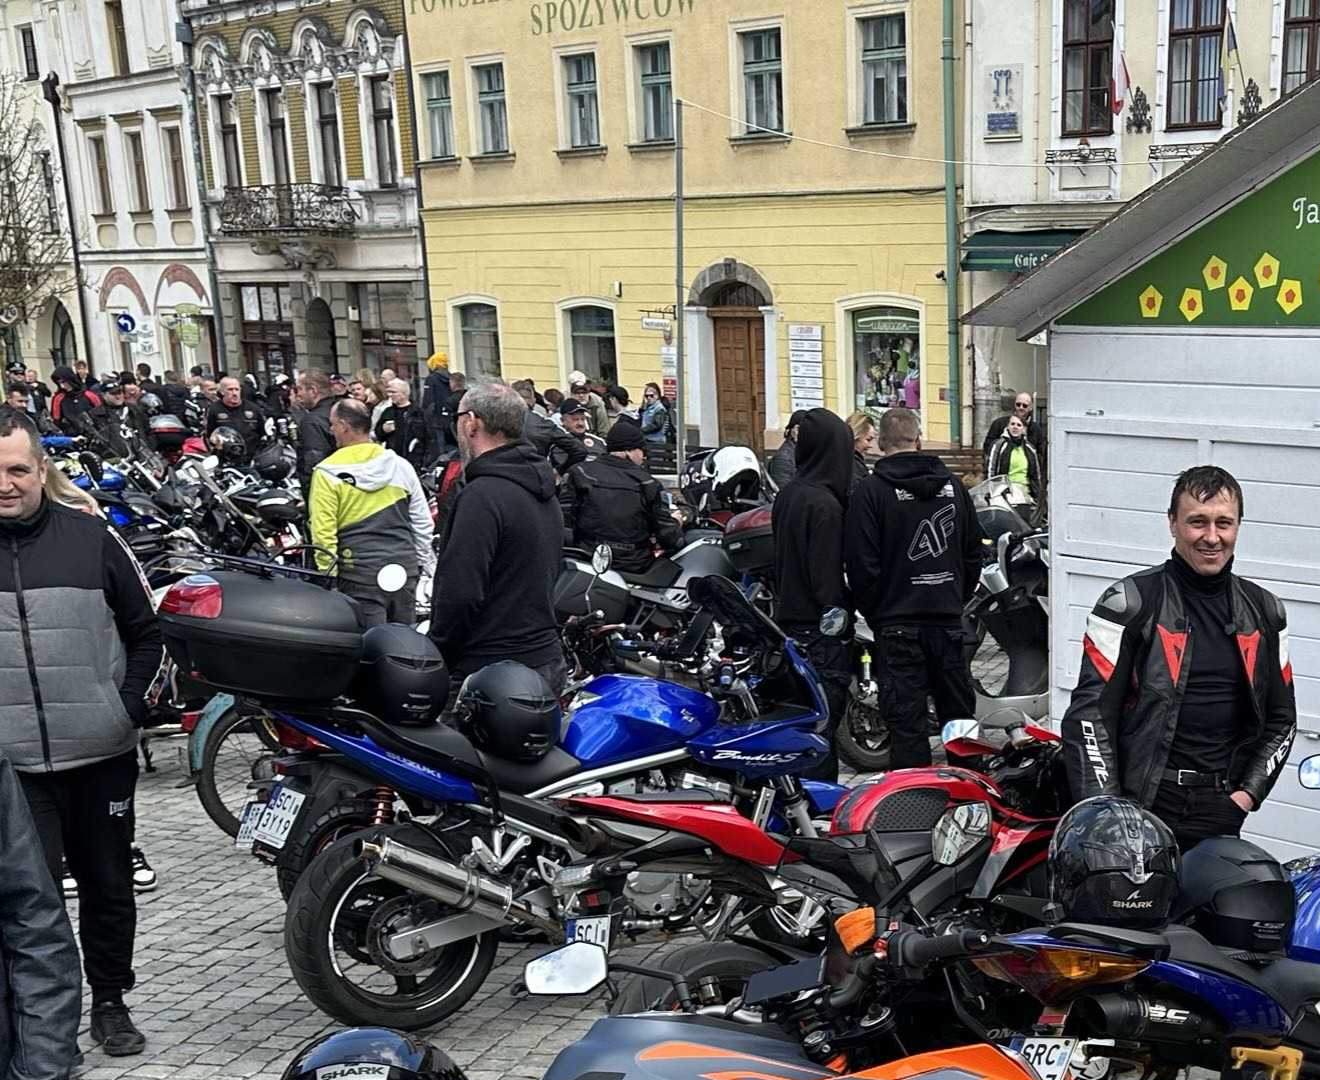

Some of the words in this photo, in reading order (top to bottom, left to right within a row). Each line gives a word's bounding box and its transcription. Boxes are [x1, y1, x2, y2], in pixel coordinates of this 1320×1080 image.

[712, 749, 781, 761] Bandit
[777, 752, 803, 763] S
[261, 812, 291, 836] 3Y19
[1112, 900, 1153, 909] SHARK
[1023, 1043, 1060, 1066] SRC
